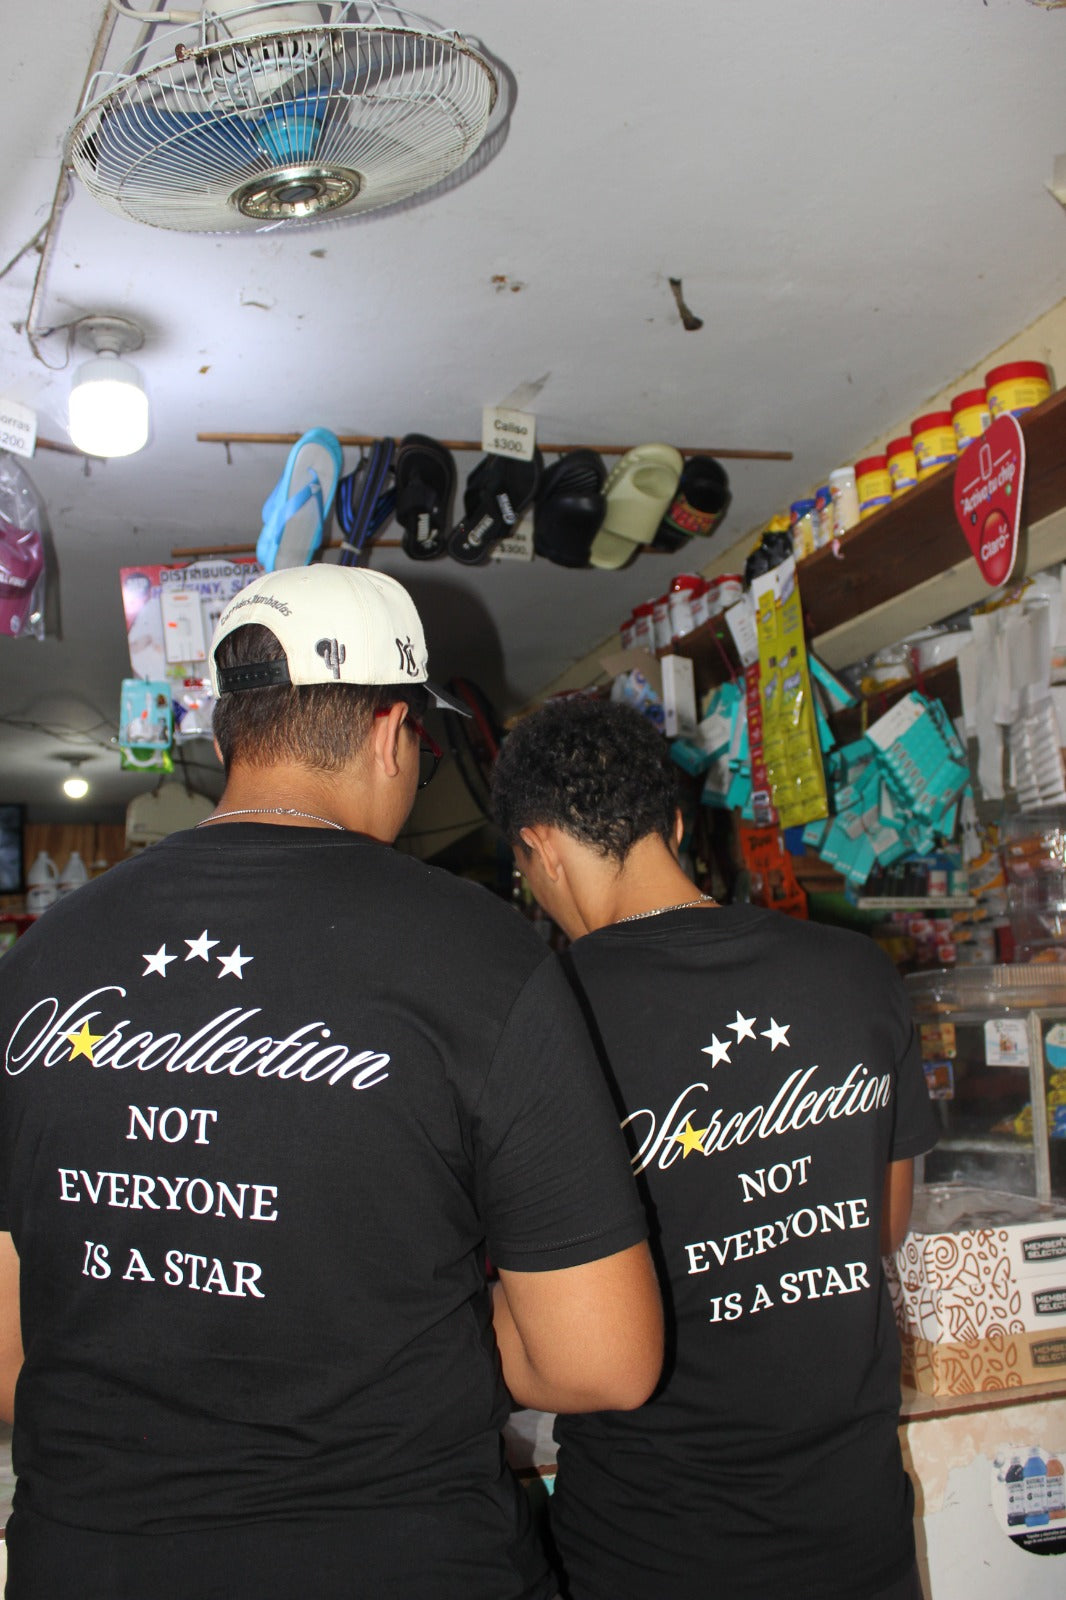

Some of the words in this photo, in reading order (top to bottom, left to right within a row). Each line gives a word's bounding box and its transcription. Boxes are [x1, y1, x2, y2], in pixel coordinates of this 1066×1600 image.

[0, 432, 24, 449] 200
[160, 563, 260, 582] DISTRIBUIDORA
[6, 986, 390, 1089] Strcollection
[126, 1105, 217, 1144] NOT
[620, 1063, 890, 1176] Strcollection
[58, 1168, 278, 1221] EVERYONE
[738, 1156, 811, 1202] NOT
[685, 1199, 869, 1274] EVERYONE
[82, 1241, 111, 1279] IS
[123, 1249, 155, 1281] A
[165, 1250, 265, 1297] STAR
[709, 1293, 742, 1322] IS
[750, 1284, 773, 1313] A
[780, 1262, 870, 1303] STAR
